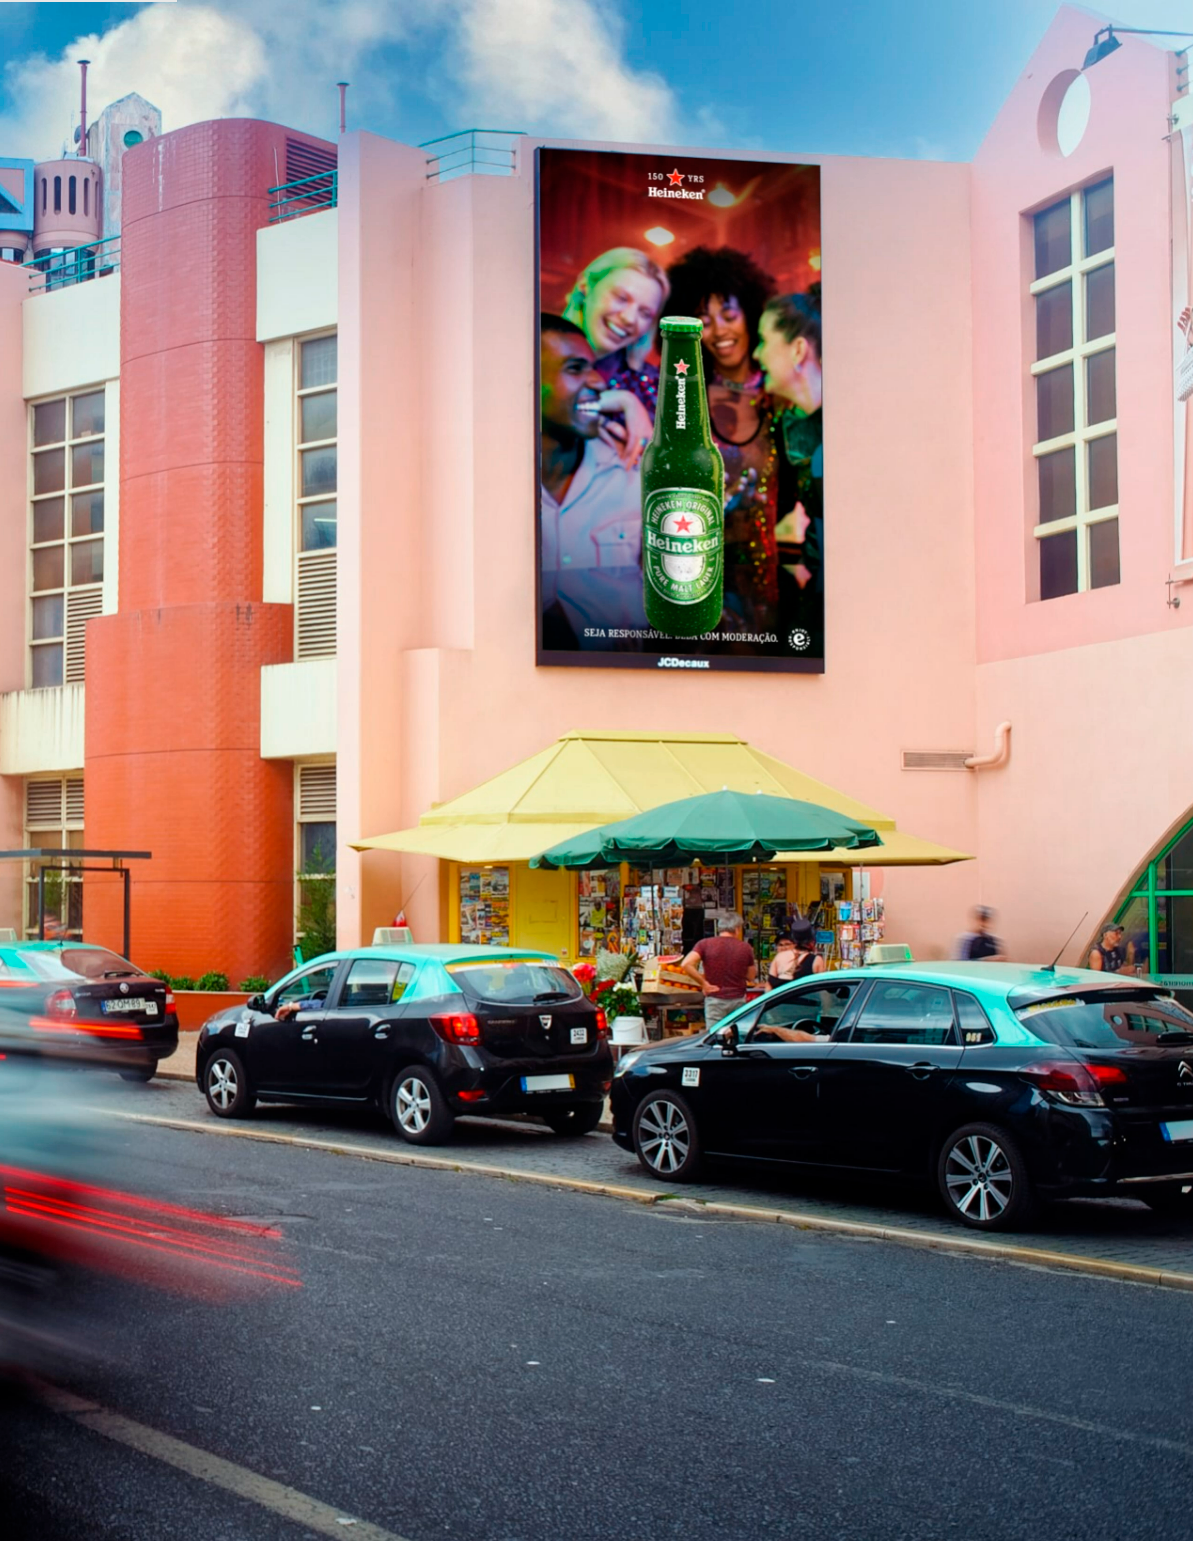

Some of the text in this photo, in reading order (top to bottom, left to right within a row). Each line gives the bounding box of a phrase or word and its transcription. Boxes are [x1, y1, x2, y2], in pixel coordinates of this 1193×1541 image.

[648, 172, 705, 183] 150 YRS
[648, 186, 704, 200] Heineken
[675, 377, 686, 430] Heineken
[647, 530, 719, 553] Heineken
[670, 583, 692, 593] MALT
[584, 628, 606, 638] SEJA
[700, 632, 720, 642] COM
[657, 657, 710, 669] JCDecaux
